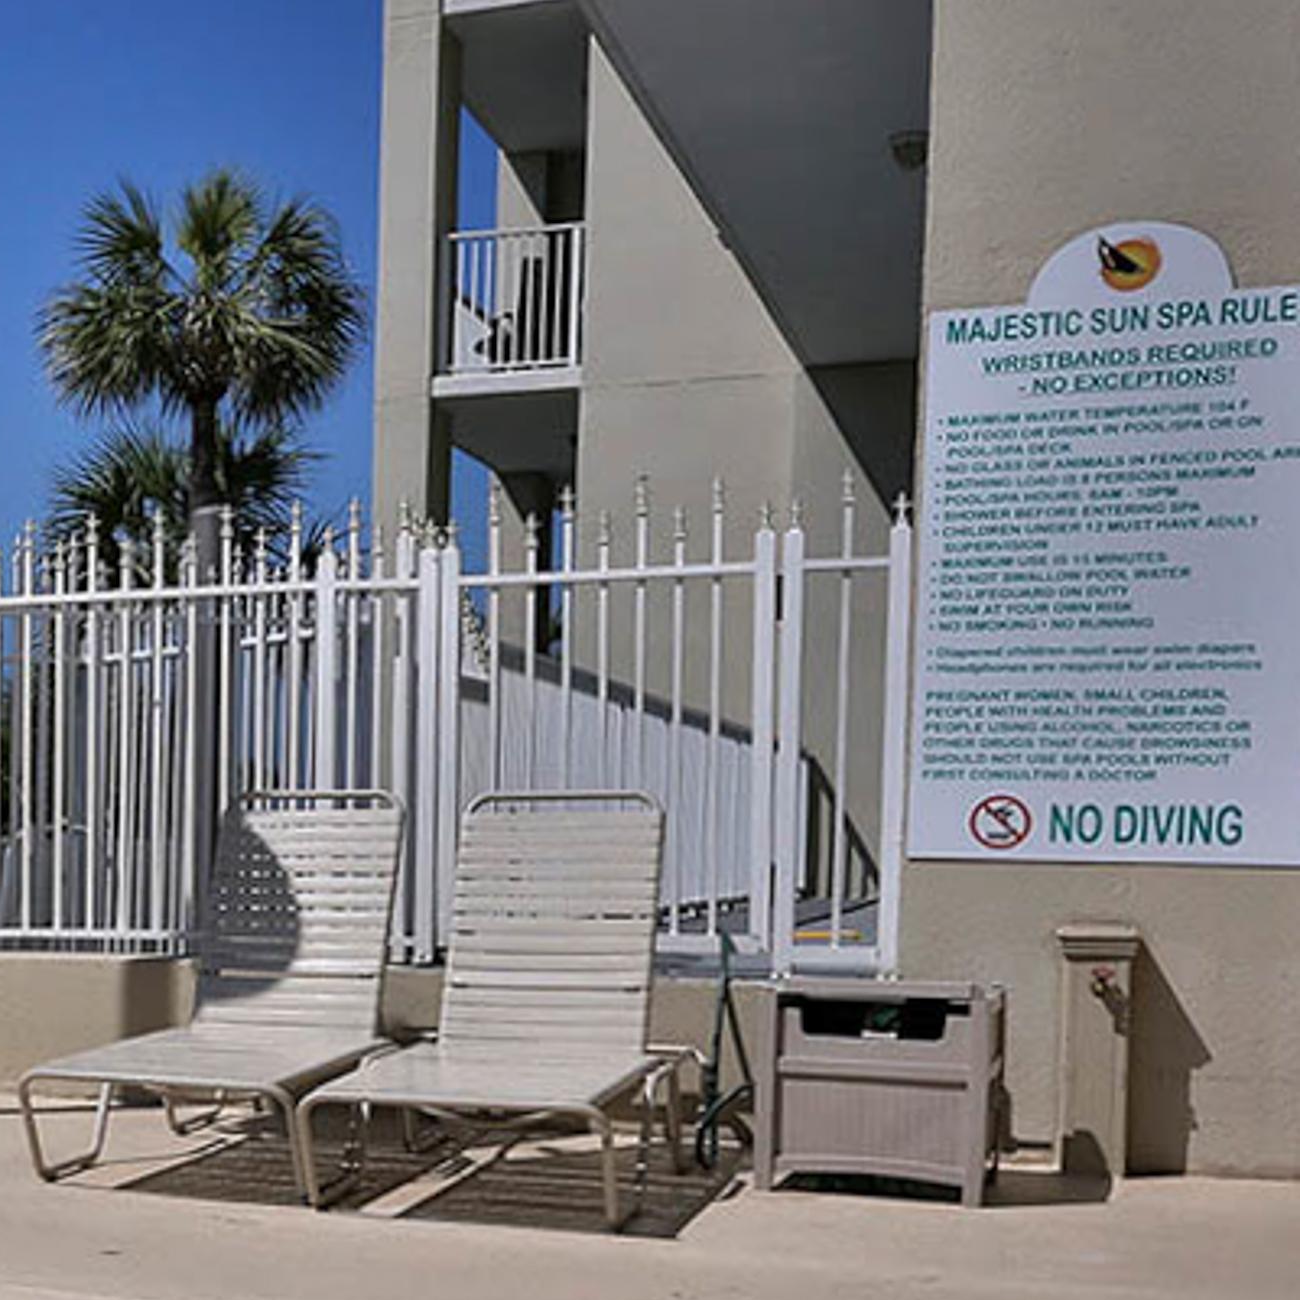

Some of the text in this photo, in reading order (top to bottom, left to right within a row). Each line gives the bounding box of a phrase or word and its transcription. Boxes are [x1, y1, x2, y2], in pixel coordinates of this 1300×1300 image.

[946, 293, 1298, 345] MAJESTIC SUN SPA RULE
[980, 337, 1279, 374] WRISTBANDS REQUIRED
[1031, 376, 1067, 394] NO
[1072, 364, 1237, 392] EXCEPTIONS!
[1024, 408, 1079, 422] WATER
[946, 430, 969, 442] NO
[972, 428, 1018, 441] FOOD
[1026, 441, 1071, 455] DECK
[945, 463, 968, 474] NO
[971, 460, 1022, 474] GLASS
[1054, 454, 1125, 470] ANIMALS
[1150, 450, 1218, 465] FENCED
[1221, 448, 1266, 462] POOL
[945, 477, 1012, 491] BATHING
[1016, 475, 1058, 488] LOAD
[1094, 468, 1171, 484] PERSONS
[1176, 465, 1255, 480] MAXIMUM
[944, 500, 1201, 522] SHOWER BEFORE ENTERING SPA
[942, 523, 1021, 537] CHILDREN
[1107, 518, 1152, 533] MUST
[1155, 517, 1199, 532] HAVE
[1205, 514, 1259, 529] ADULT
[1017, 554, 1047, 567] USE
[1094, 551, 1168, 565] MINUTES
[940, 566, 1192, 585] DO NOT SWALLOW POOL WATER
[940, 588, 962, 601] NO
[965, 586, 1056, 600] LIFEGUARD
[1086, 584, 1129, 597] DUTY
[938, 616, 1155, 632] NO SMOKING NO RUNNING
[925, 689, 1009, 701] PREGNANT
[1083, 688, 1134, 701] SMALL
[925, 704, 1226, 718] PEOPLE WITH HEALTH PROBLEMS AND
[924, 722, 985, 734] PEOPLE
[987, 721, 1038, 733] USING
[1126, 721, 1221, 733] NARCOTICS
[1225, 720, 1251, 733] OR
[1038, 737, 1078, 748] THAT
[1082, 736, 1136, 749] CAUSE
[923, 753, 988, 765] SHOULD
[990, 753, 1022, 765] NOT
[1153, 753, 1231, 766] WITHOUT
[922, 769, 1158, 782] FIRST CONSULTING A DOCTOR
[1049, 803, 1244, 847] NO DIVING
